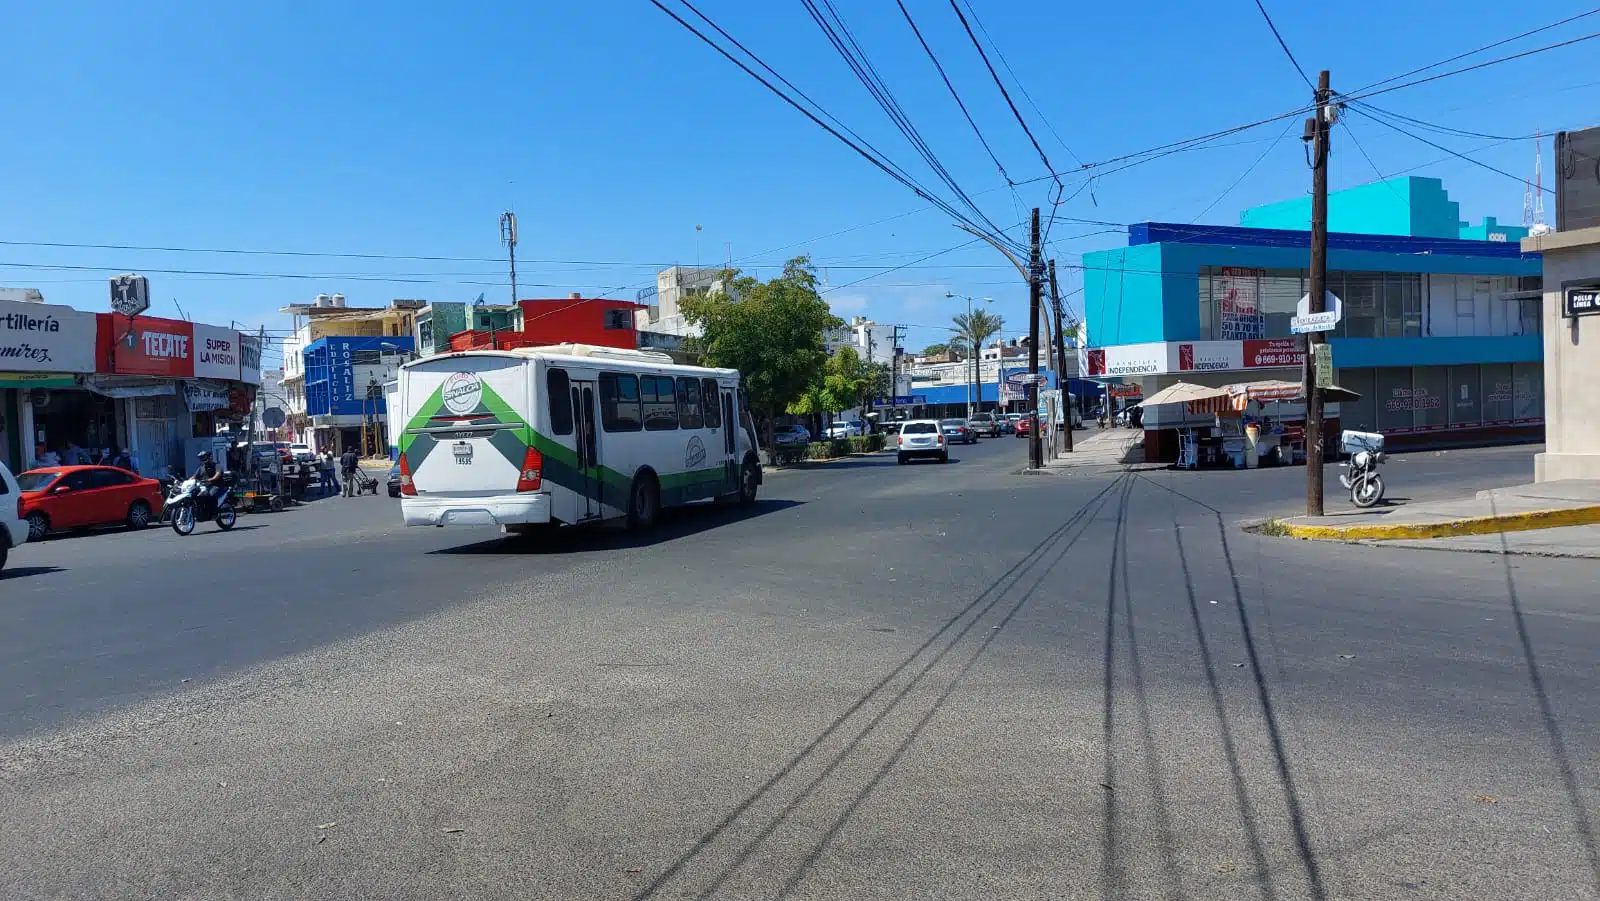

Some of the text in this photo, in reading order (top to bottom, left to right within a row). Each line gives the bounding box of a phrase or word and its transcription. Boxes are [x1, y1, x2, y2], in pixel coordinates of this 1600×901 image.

[142, 331, 188, 359] TECATE
[206, 338, 231, 352] SUPER
[200, 351, 211, 364] LA
[212, 353, 236, 366] MISION
[342, 342, 353, 401] ROSALIZ
[1109, 364, 1158, 375] INDEPENDENCIA
[444, 381, 480, 400] SINALOA
